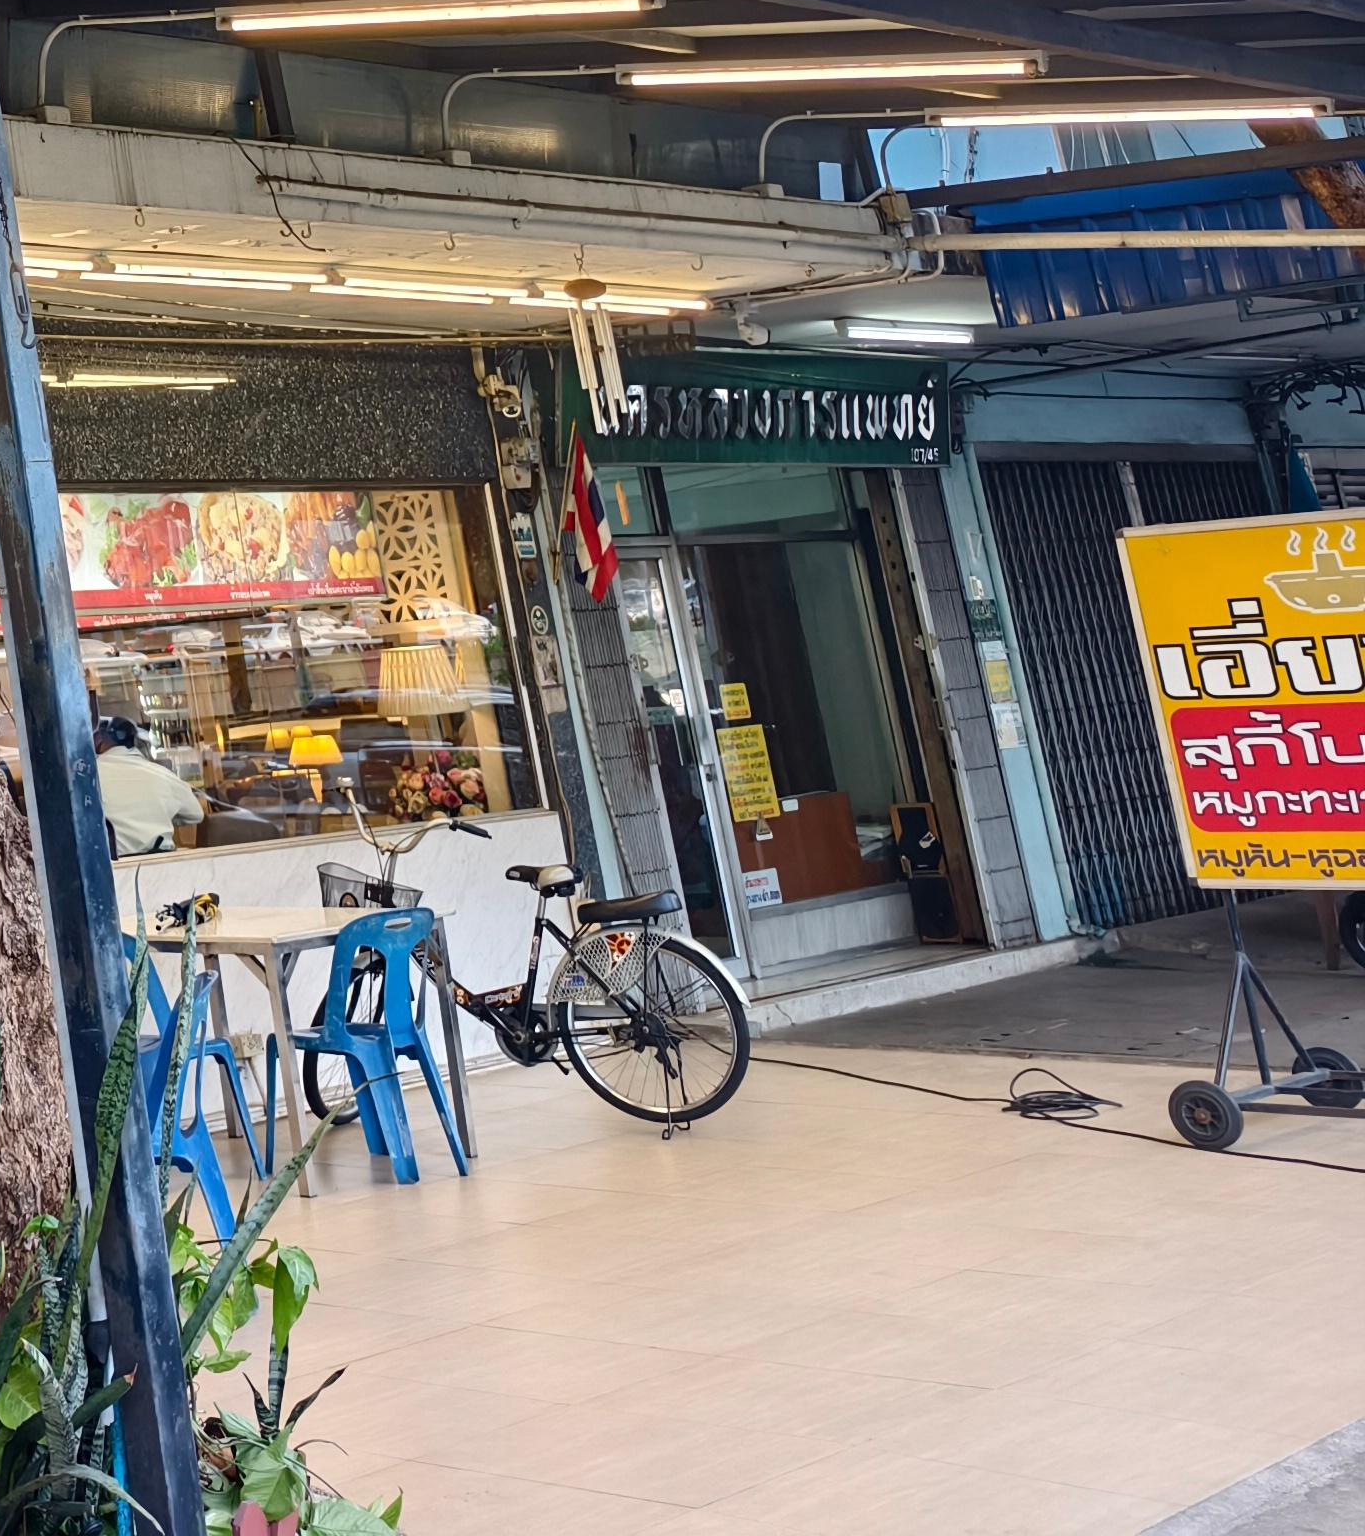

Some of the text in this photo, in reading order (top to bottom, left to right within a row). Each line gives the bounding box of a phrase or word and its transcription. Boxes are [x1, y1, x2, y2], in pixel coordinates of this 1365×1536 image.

[1153, 596, 1365, 701] เอี่ย
[1191, 788, 1365, 828] หมูกะทะเ
